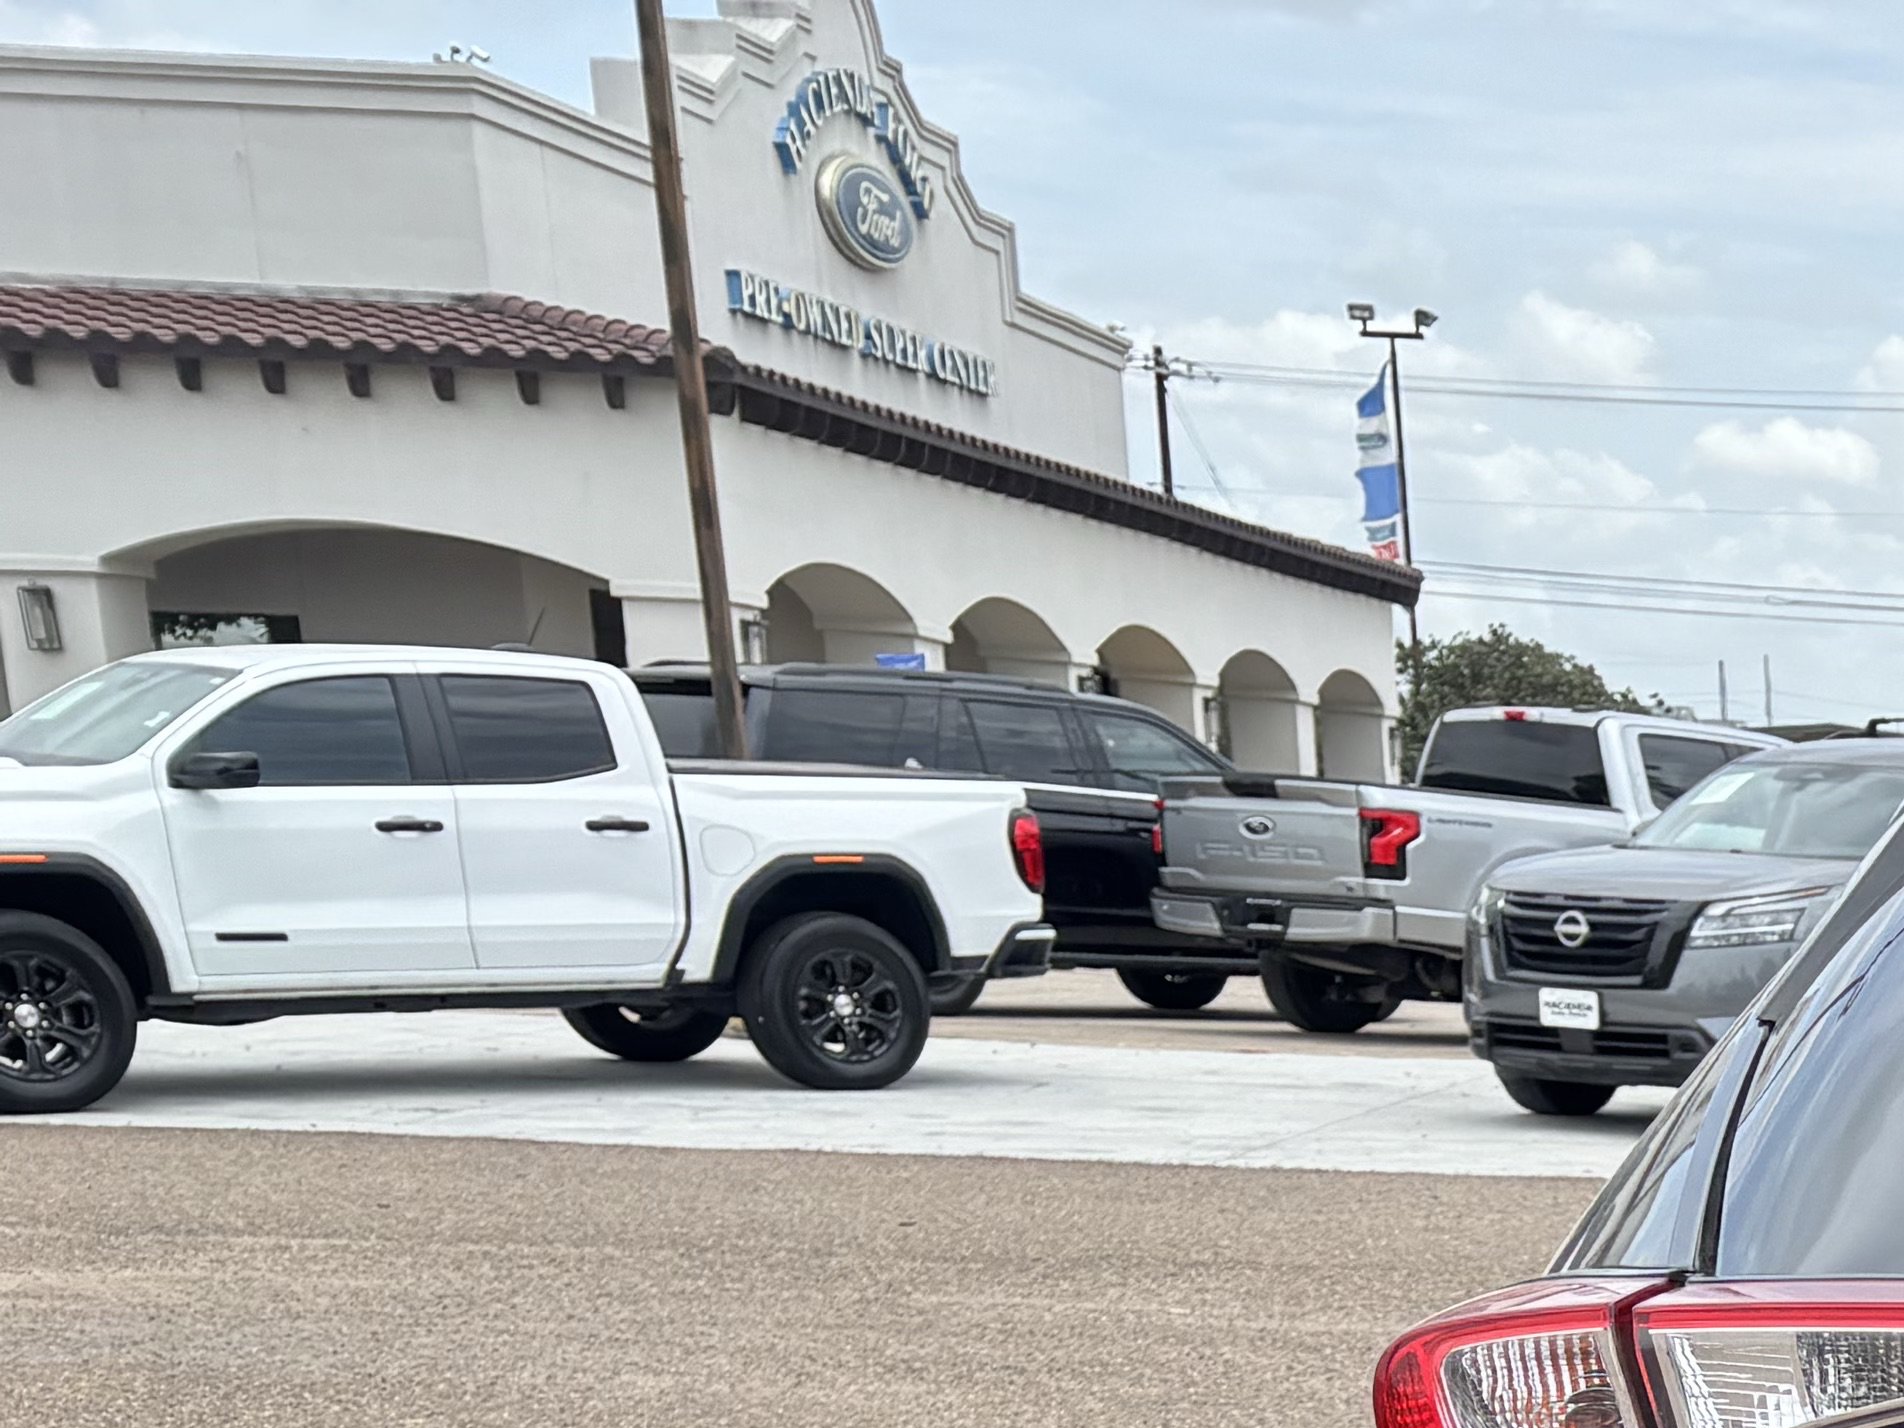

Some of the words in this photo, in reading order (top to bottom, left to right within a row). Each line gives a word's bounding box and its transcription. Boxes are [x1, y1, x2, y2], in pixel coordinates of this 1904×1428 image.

[780, 67, 879, 172] HACIENDA
[884, 103, 935, 214] FORD
[855, 179, 904, 248] Ford
[738, 270, 865, 350] PRE-OWNED
[868, 319, 931, 373] SUPER
[932, 340, 998, 397] CENTER
